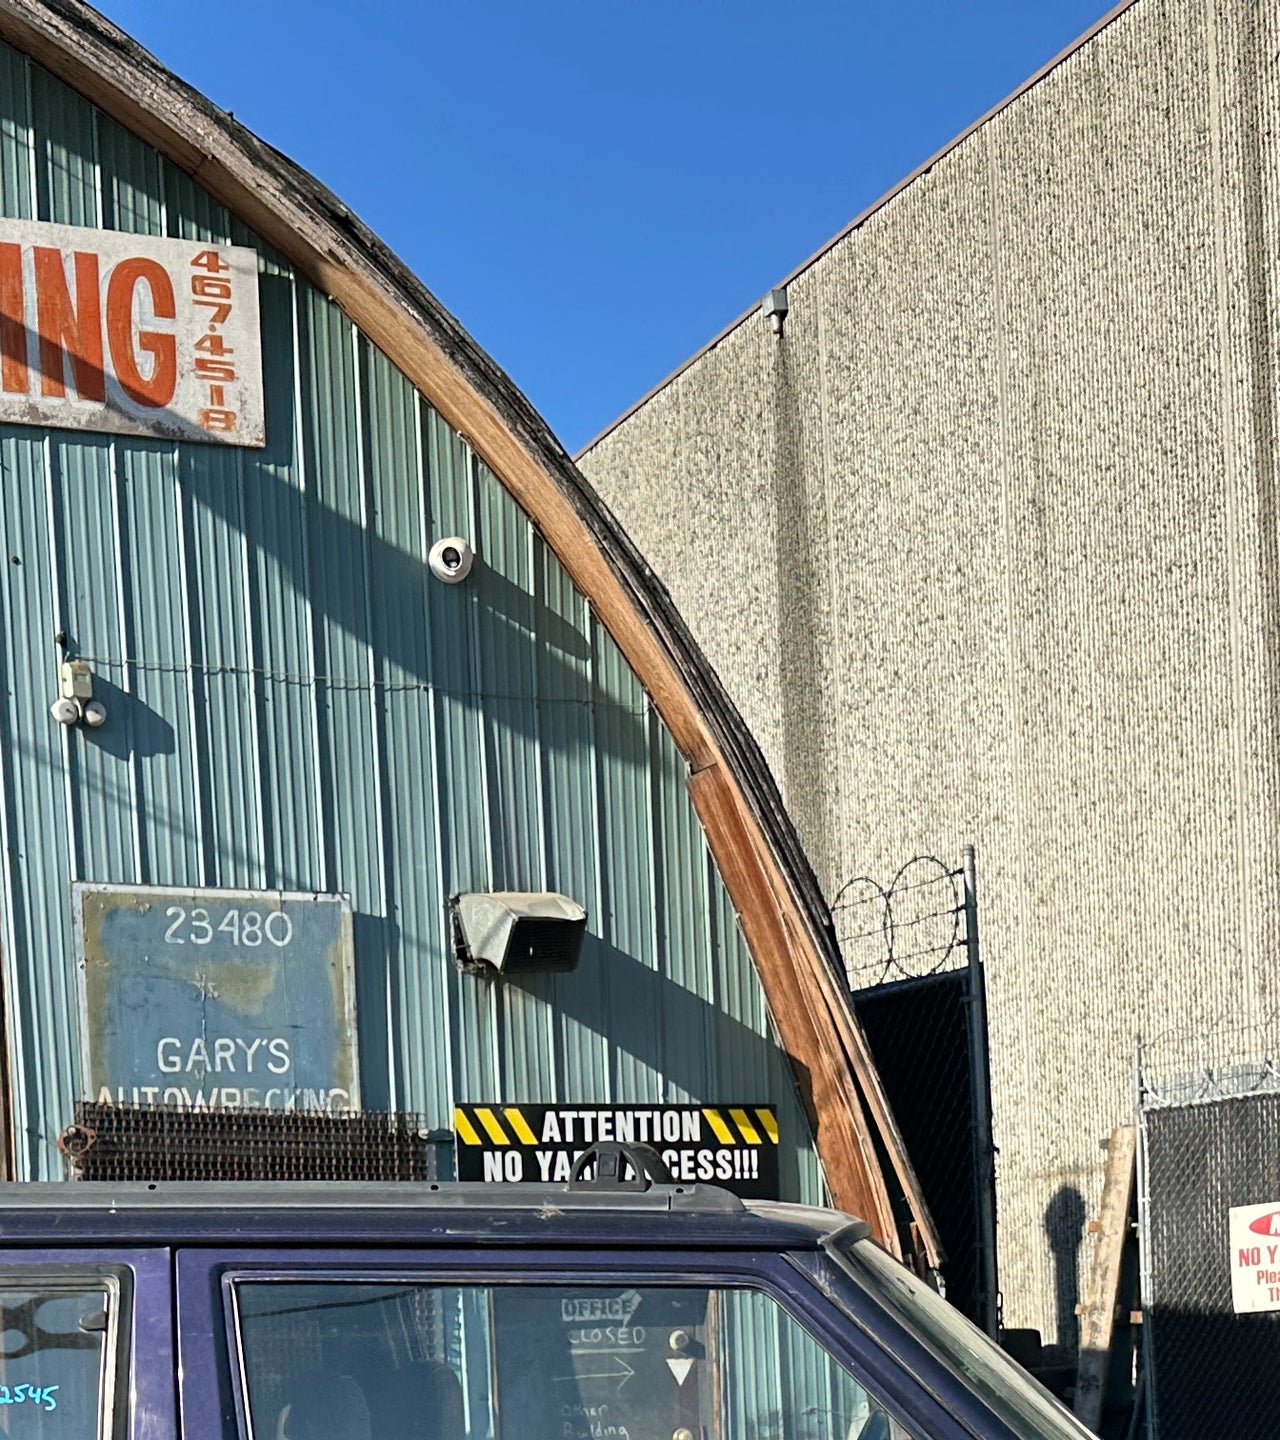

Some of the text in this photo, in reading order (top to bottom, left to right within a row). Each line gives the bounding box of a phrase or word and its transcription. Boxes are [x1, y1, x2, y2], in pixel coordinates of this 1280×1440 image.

[164, 906, 293, 947] 23480
[157, 1037, 290, 1074] GARY'S
[541, 1110, 701, 1142] ATTENTION
[483, 1150, 523, 1182] NO
[1239, 1247, 1261, 1268] NO
[562, 1299, 636, 1321] OFFICE
[568, 1326, 645, 1345] CLOSED
